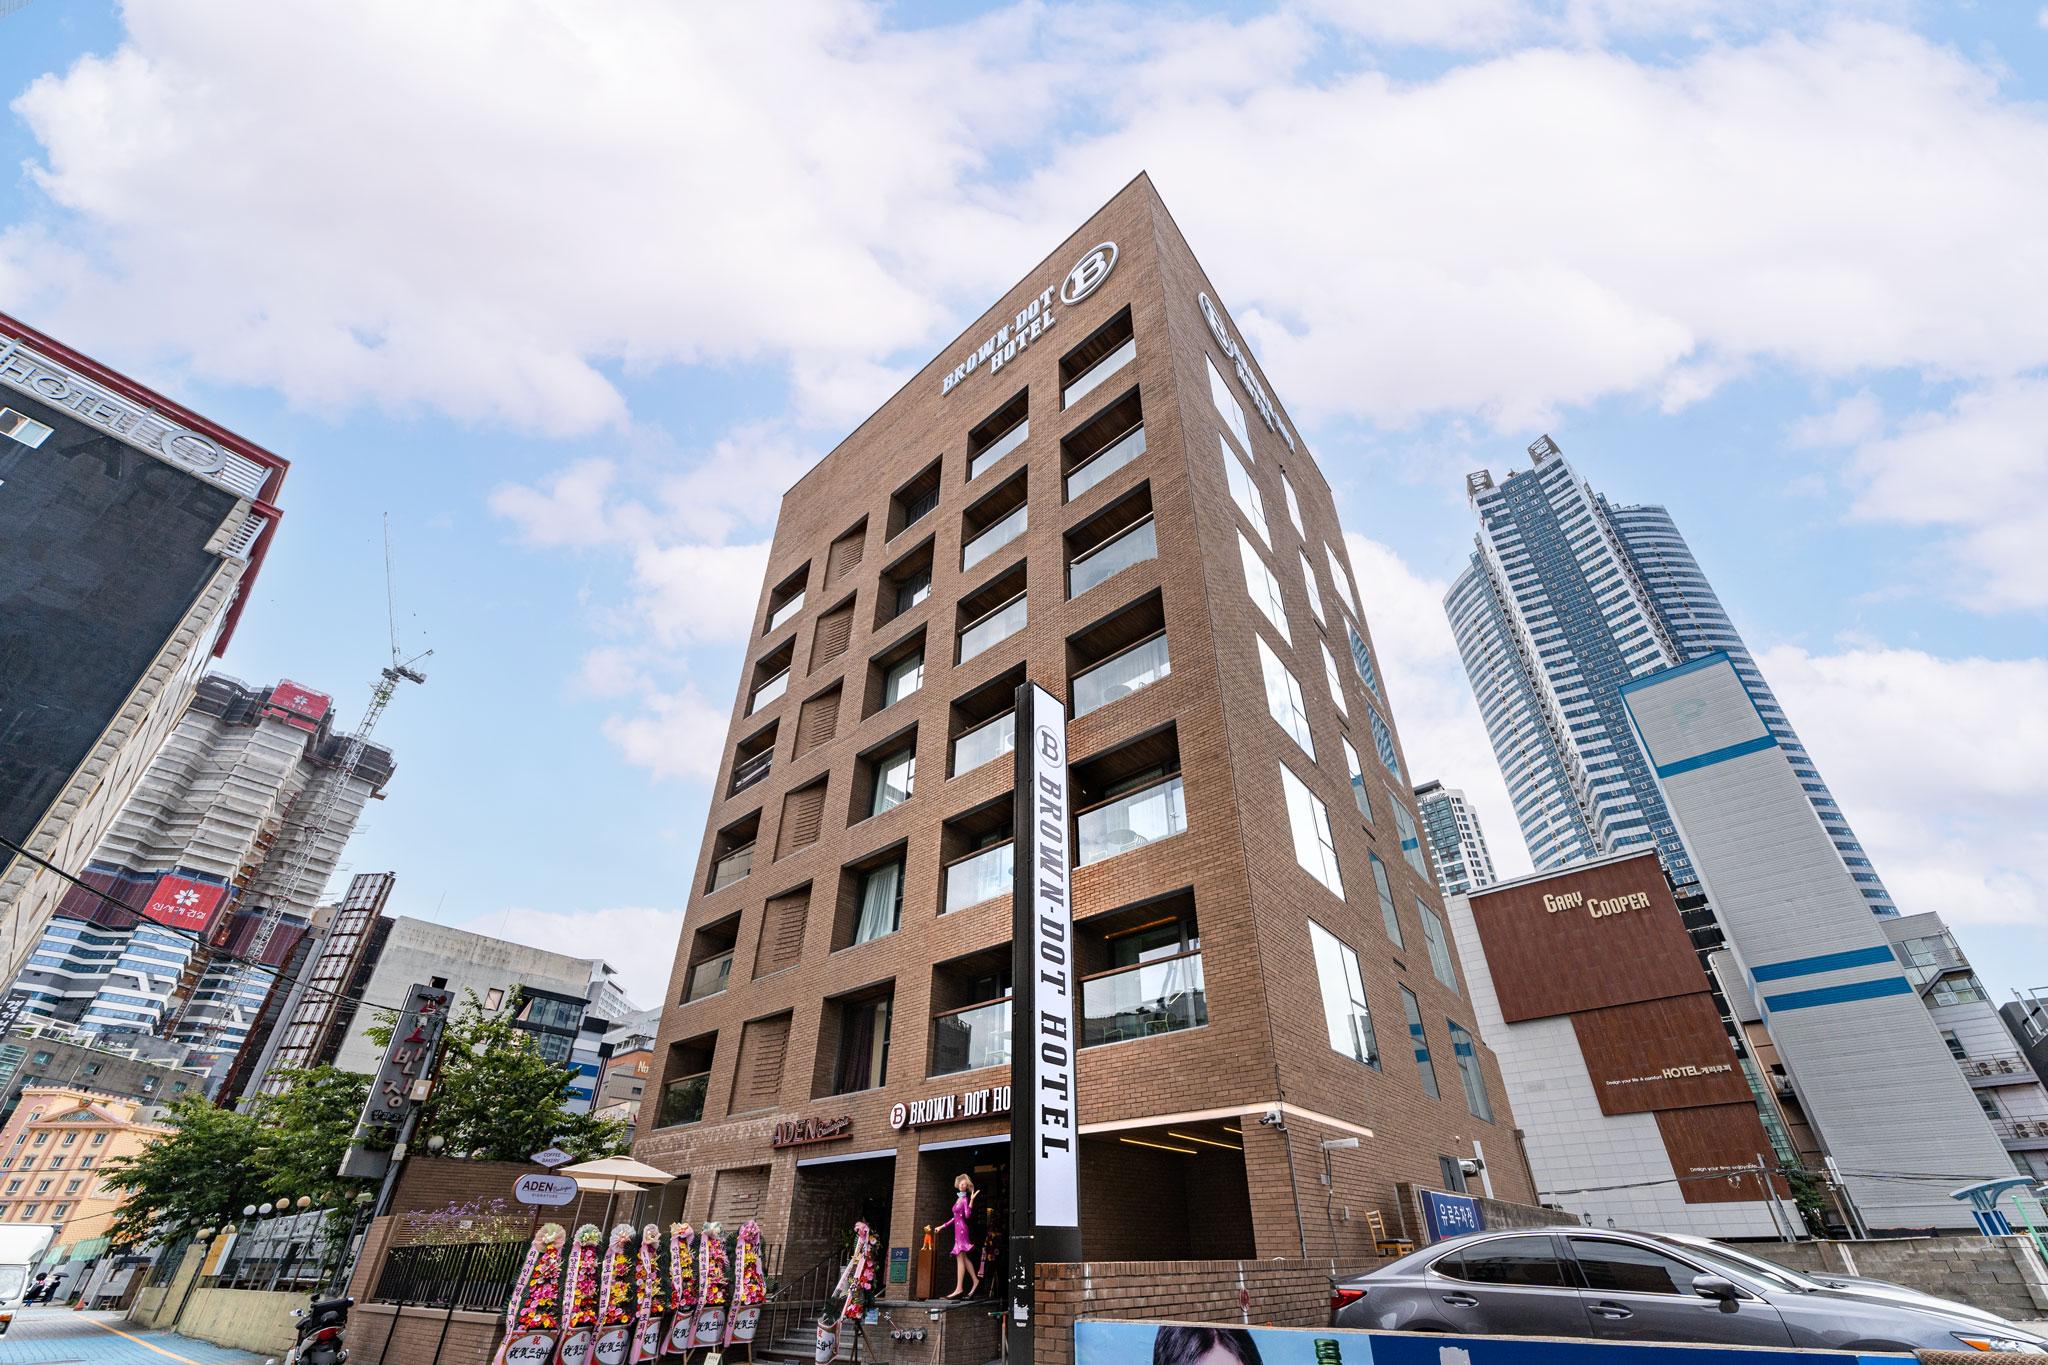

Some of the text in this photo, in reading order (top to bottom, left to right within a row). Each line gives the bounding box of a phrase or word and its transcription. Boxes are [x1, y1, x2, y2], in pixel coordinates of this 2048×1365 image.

[990, 310, 1057, 376] HOTEL
[0, 356, 126, 433] HOTEL
[1041, 1010, 1069, 1158] HOTEL
[1662, 1065, 1701, 1079] HOTEL
[772, 1117, 819, 1145] ADEN
[522, 1181, 553, 1192] ADEN
[1440, 1203, 1475, 1229] 유료주차장
